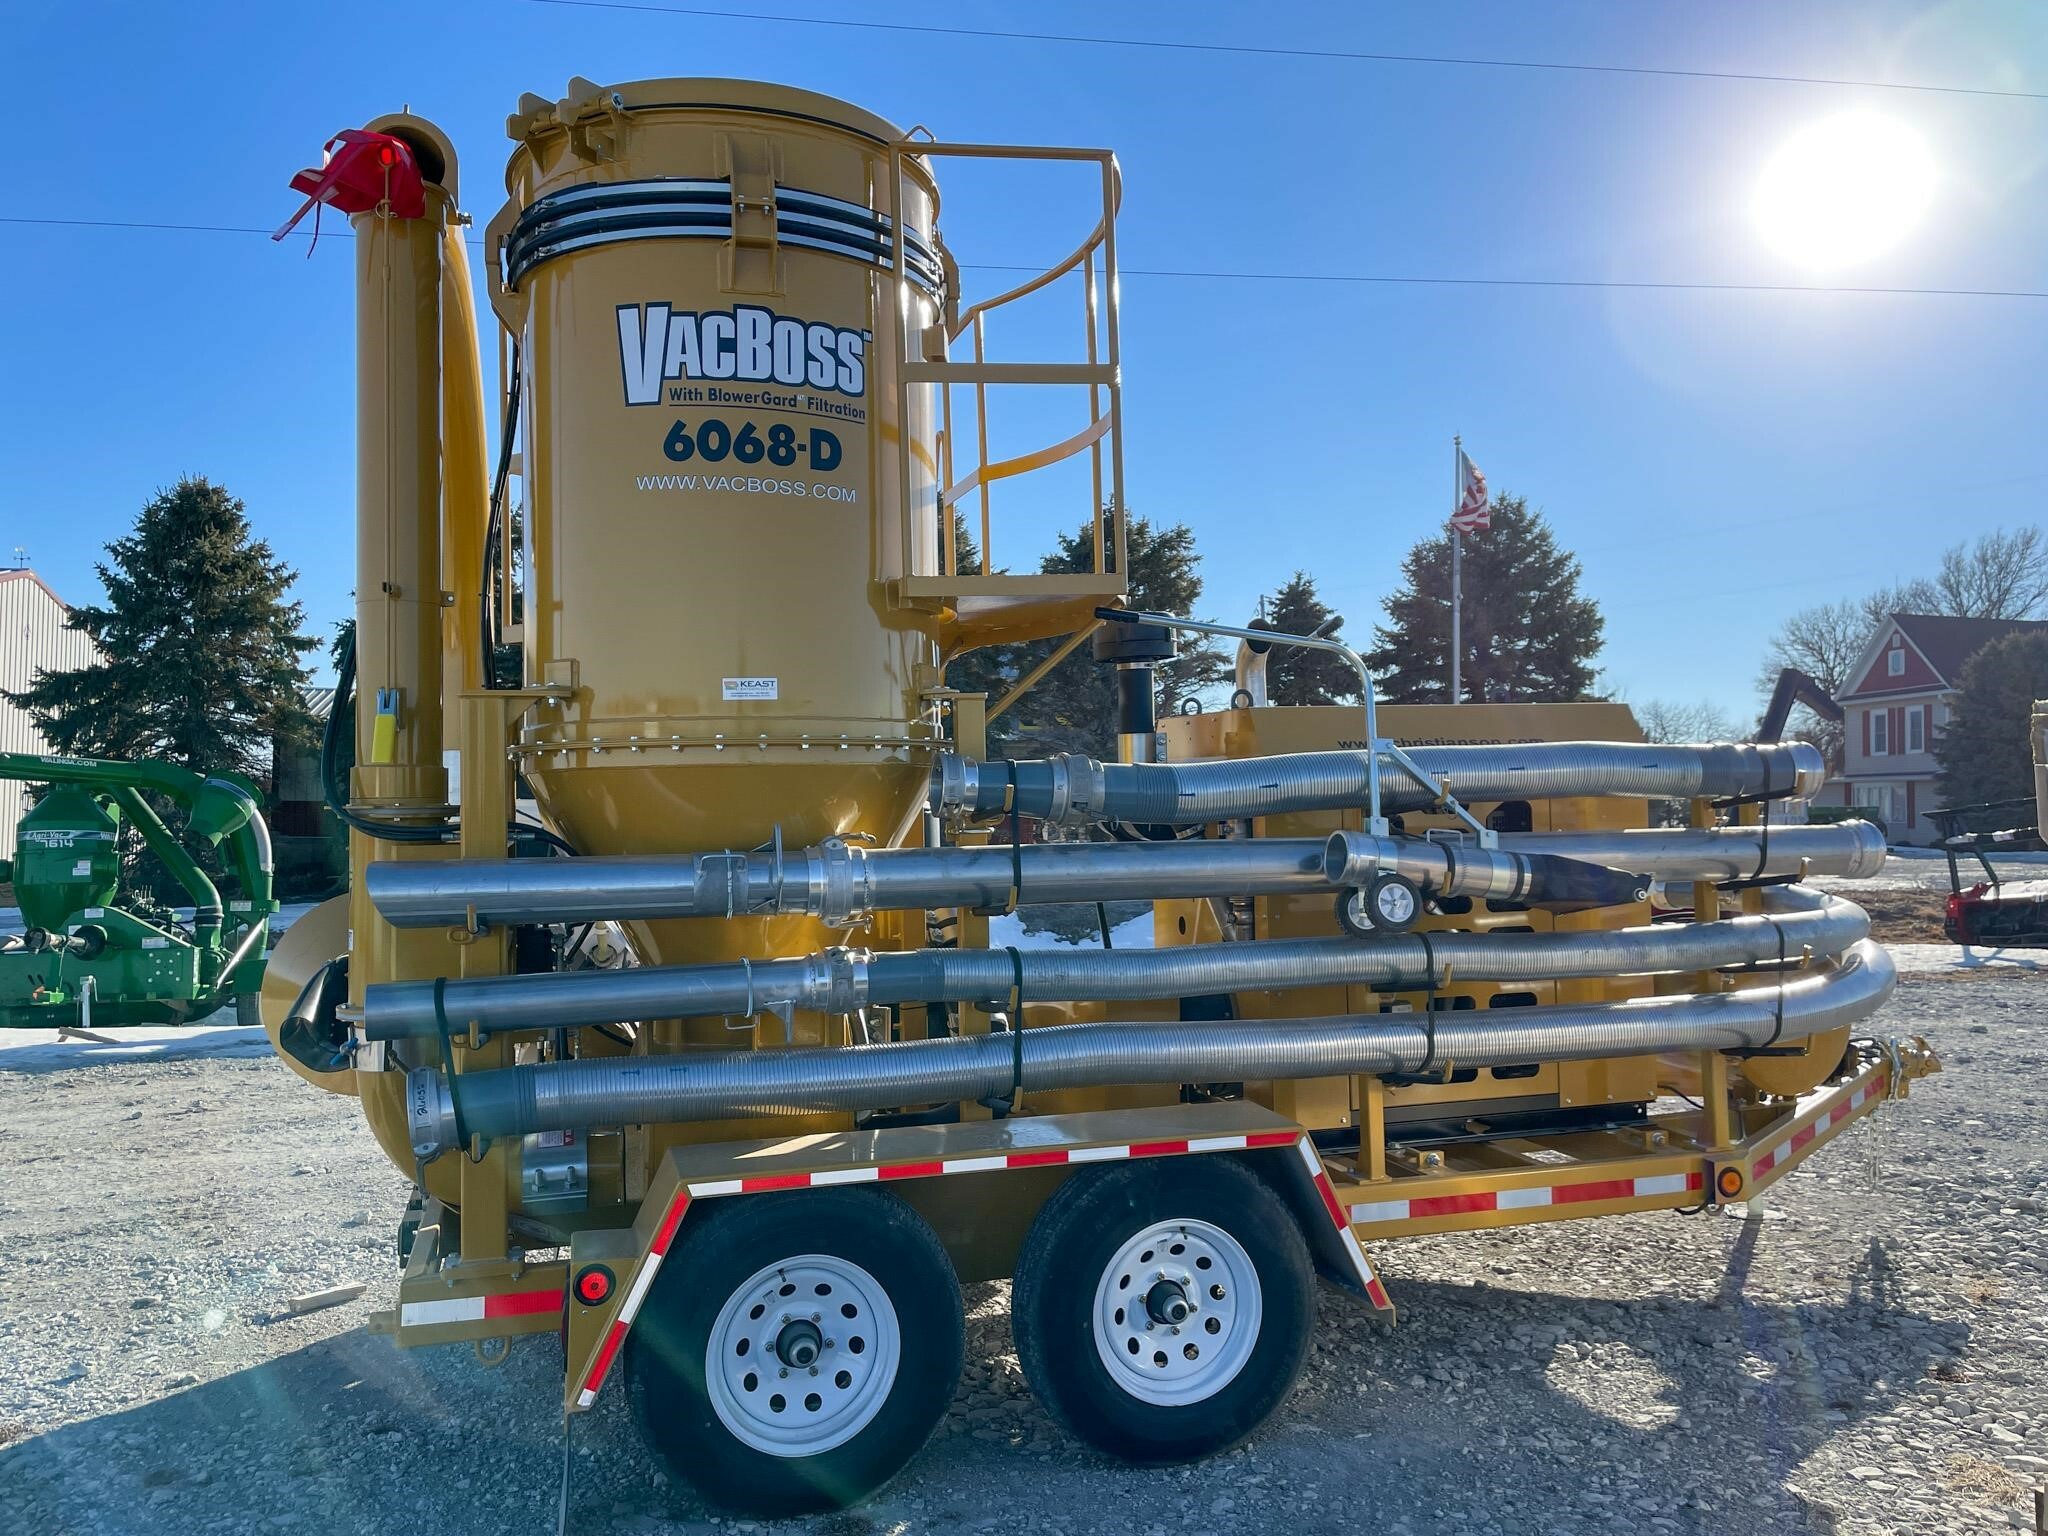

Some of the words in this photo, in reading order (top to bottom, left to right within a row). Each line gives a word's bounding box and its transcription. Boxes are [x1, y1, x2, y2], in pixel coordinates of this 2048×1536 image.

[669, 387, 703, 402] With
[708, 388, 798, 408] BlowerGard
[807, 396, 866, 419] Filtration
[663, 419, 842, 471] 6068-D
[636, 475, 857, 502] WWW.VACBOSS.COM
[740, 680, 776, 688] KEAST
[40, 839, 75, 848] 7614
